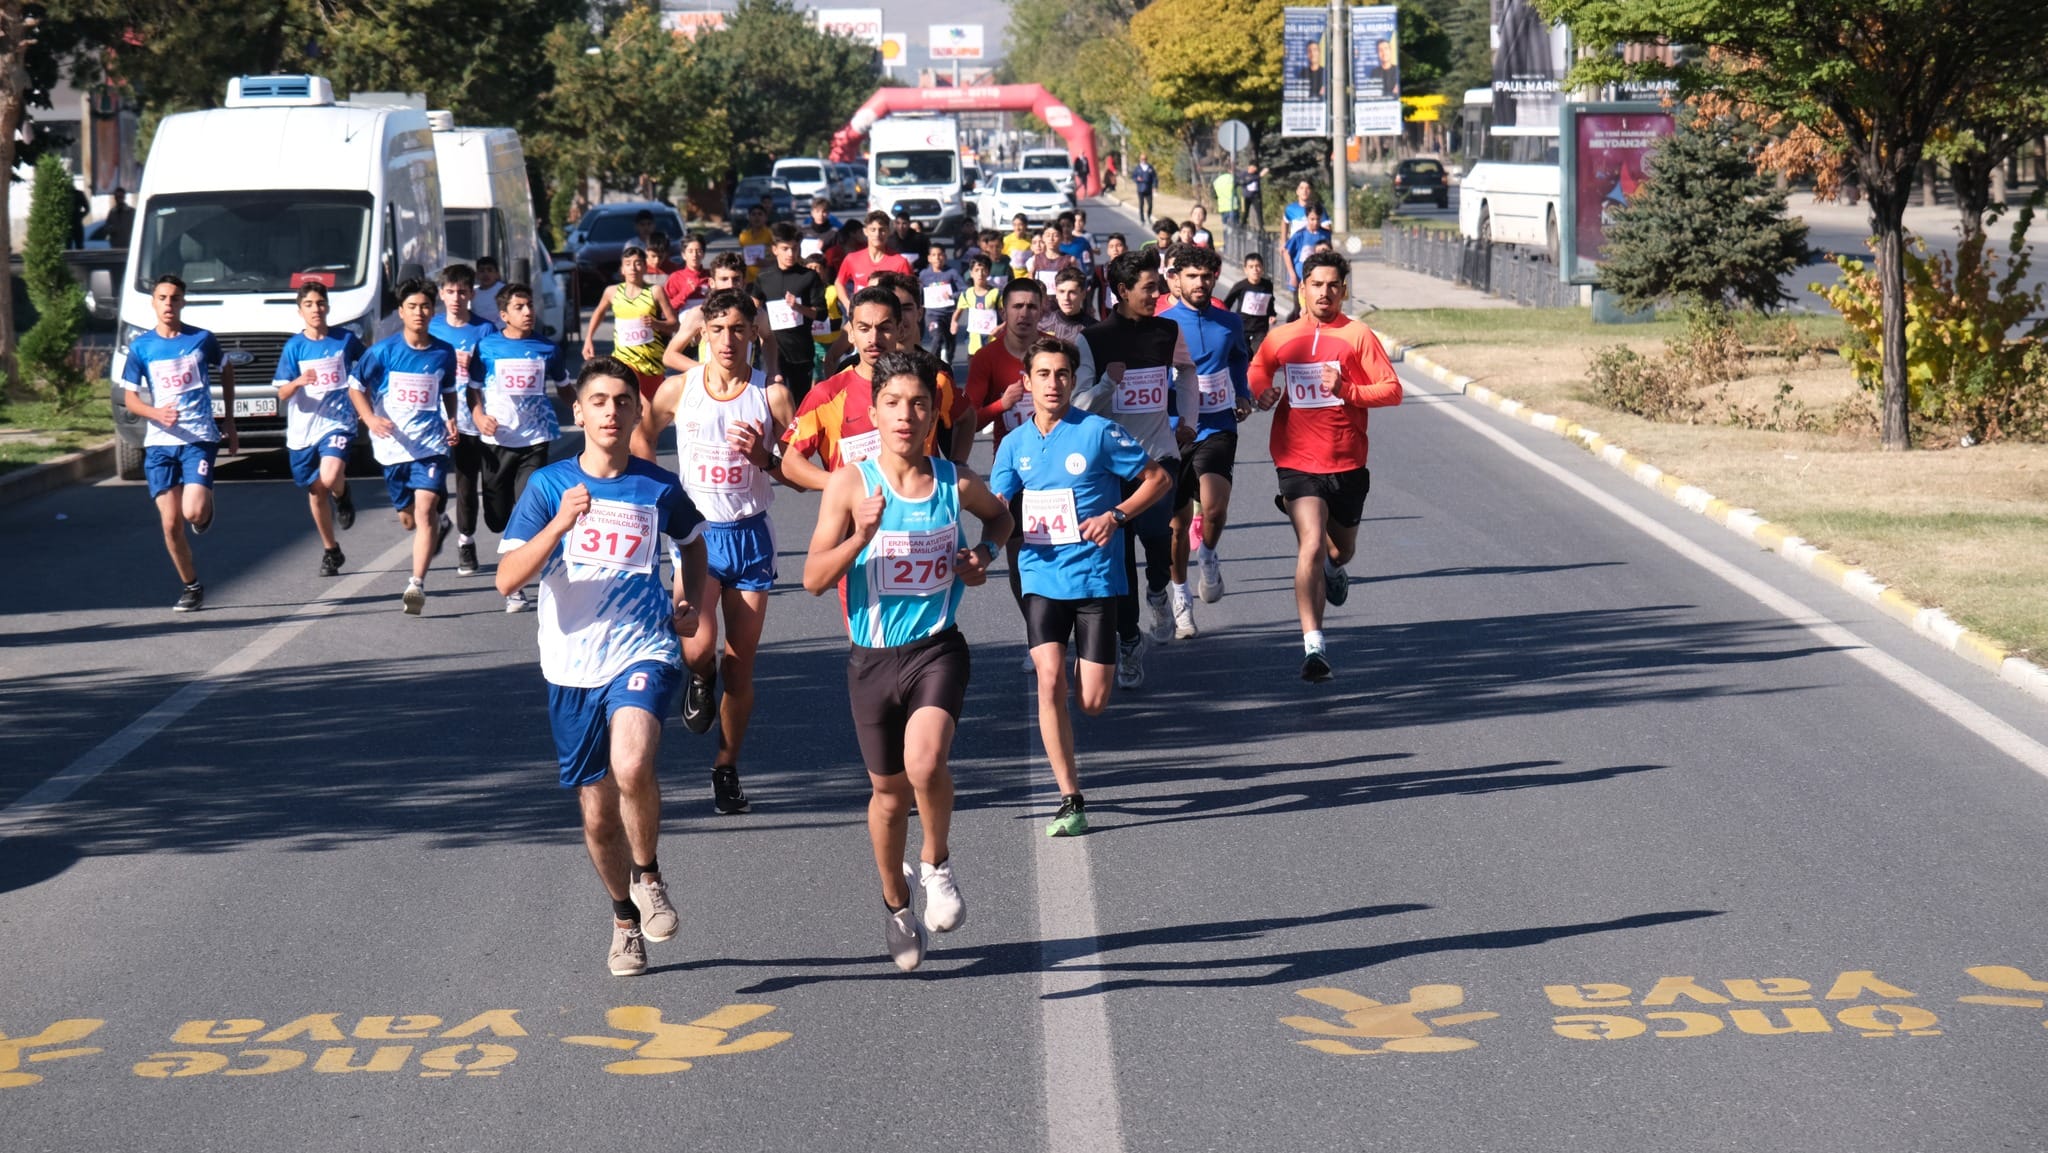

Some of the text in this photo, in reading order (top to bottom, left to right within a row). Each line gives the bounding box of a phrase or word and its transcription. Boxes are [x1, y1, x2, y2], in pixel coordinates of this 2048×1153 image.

[1495, 80, 1561, 92] PAULMARK
[625, 329, 648, 341] 200
[162, 372, 193, 389] 350
[505, 375, 537, 389] 352
[397, 389, 430, 404] 353
[1124, 387, 1162, 406] 250
[1296, 383, 1332, 400] 019
[256, 400, 275, 412] 503
[698, 464, 743, 485] 198
[1028, 514, 1067, 535] 214
[581, 528, 643, 559] 317
[894, 555, 948, 584] 276
[627, 672, 649, 691] 6
[1544, 970, 1919, 1008] yaya
[169, 1008, 527, 1045] yaya
